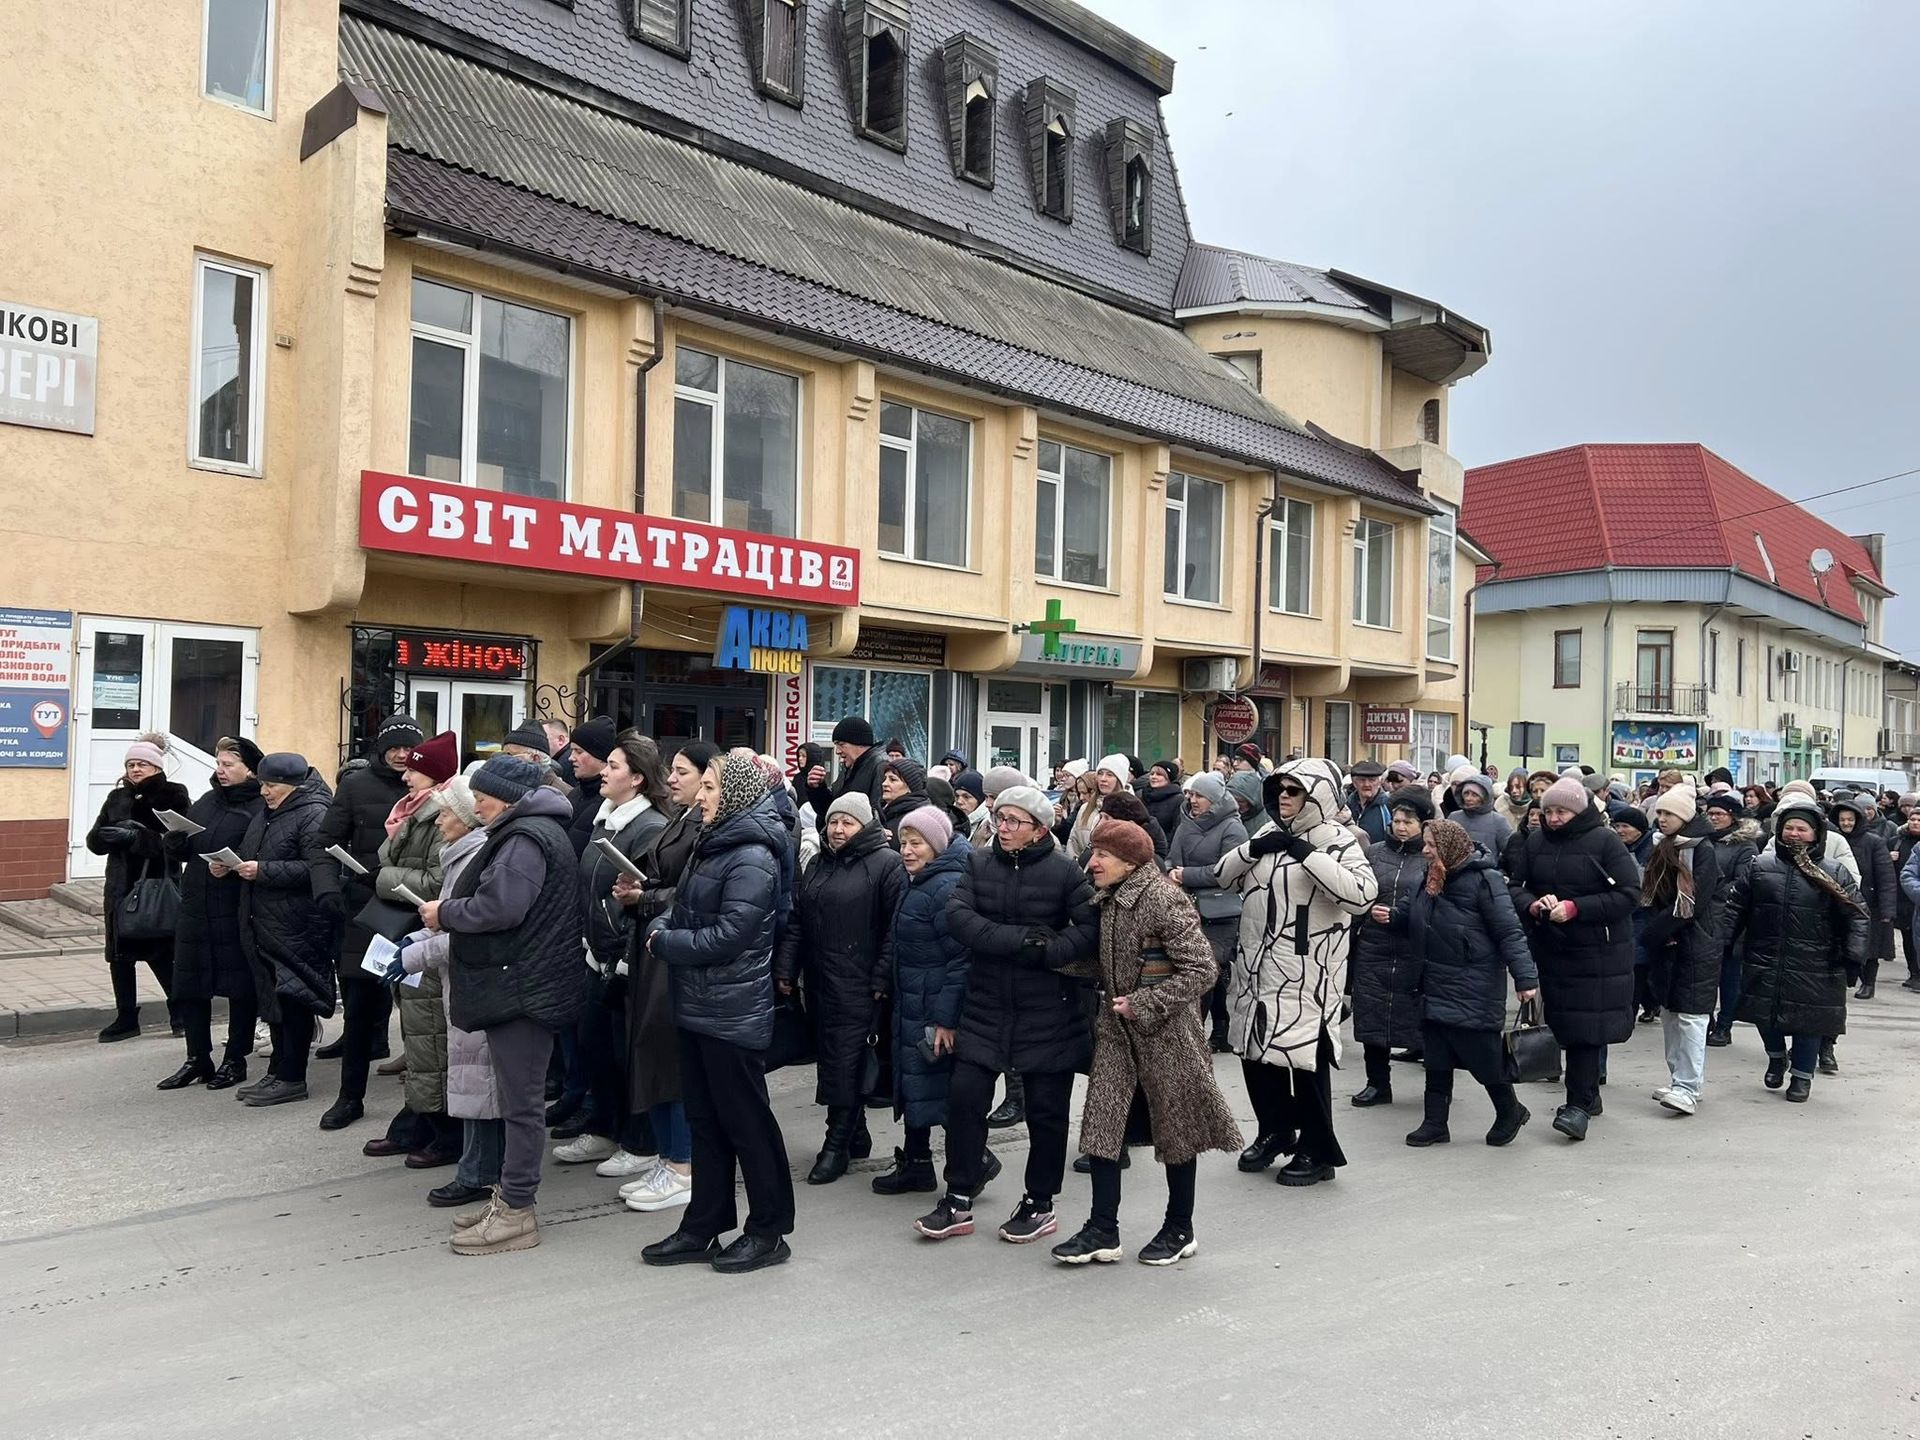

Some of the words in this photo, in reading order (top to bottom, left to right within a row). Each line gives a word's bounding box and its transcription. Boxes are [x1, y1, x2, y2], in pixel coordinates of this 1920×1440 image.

[0, 310, 78, 348] КОВІ
[378, 486, 537, 550] СВІТ
[559, 513, 823, 590] МАТРАЦІВ
[836, 559, 847, 580] 2
[1, 640, 61, 651] ПРИДБАТИ
[716, 606, 809, 670] АКВА
[1040, 641, 1122, 667] ПТЕКА
[0, 661, 54, 672] ЗКОВОГО
[31, 673, 67, 683] ВОДІЯ
[36, 711, 60, 719] ТУТ
[1366, 712, 1407, 724] ДИТЯЧА
[1616, 746, 1695, 761] КАПІТОШКА
